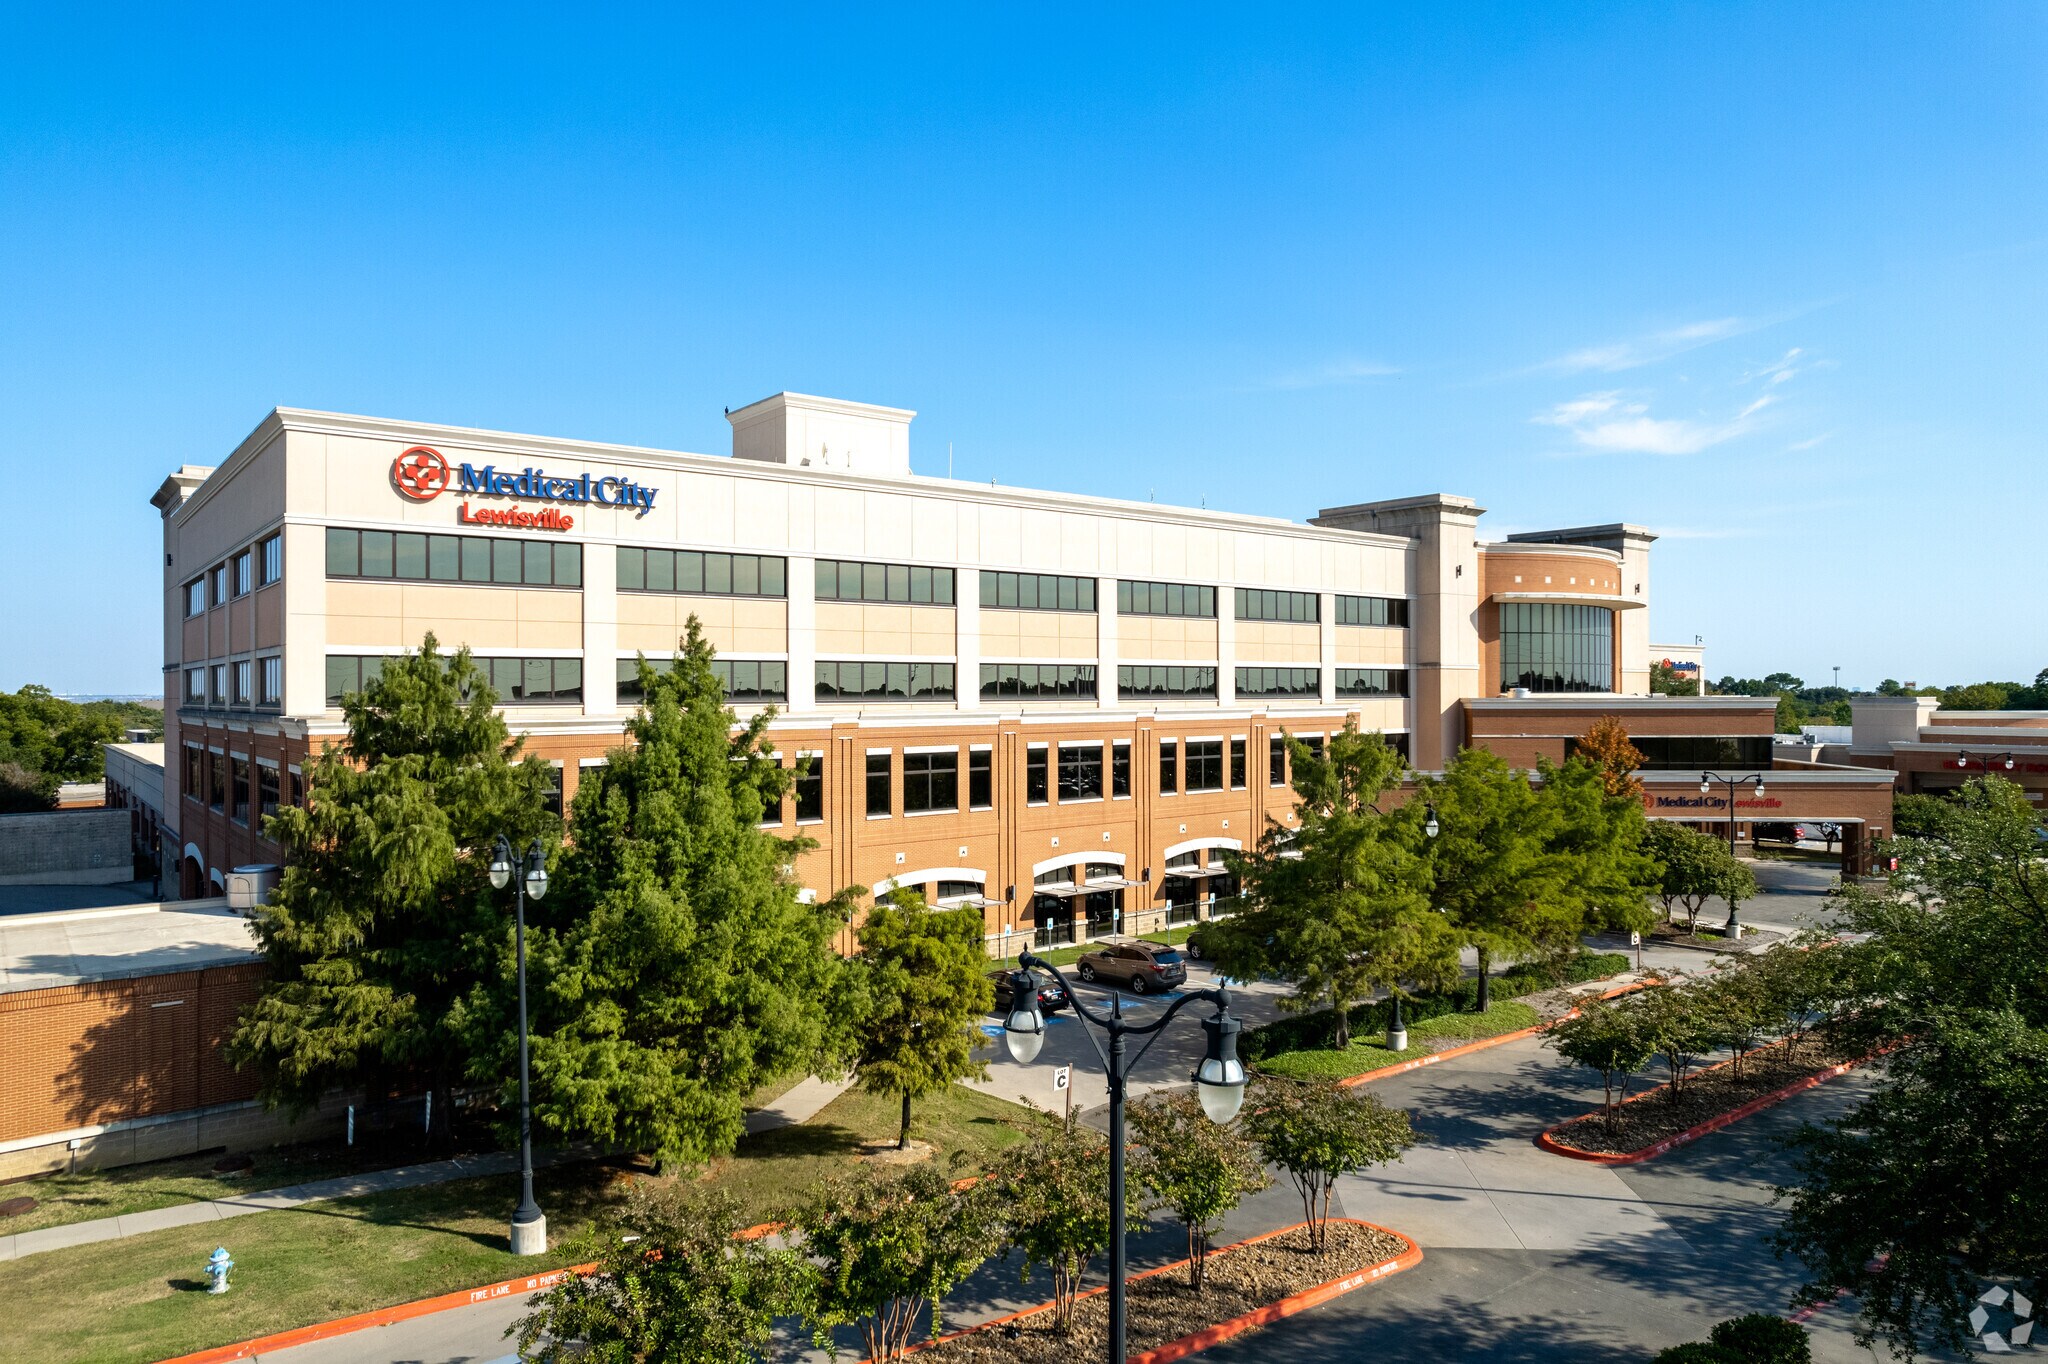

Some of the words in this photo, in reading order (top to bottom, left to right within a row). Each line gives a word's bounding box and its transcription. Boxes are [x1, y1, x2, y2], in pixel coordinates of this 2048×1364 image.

[459, 463, 592, 502] Medical
[596, 475, 660, 515] City
[463, 501, 574, 530] Lewisville
[1657, 796, 1703, 808] Medical
[1704, 796, 1728, 810] City
[1057, 1074, 1066, 1088] C
[470, 1289, 488, 1303] FIRE
[491, 1284, 511, 1297] LANE
[527, 1278, 537, 1289] NO
